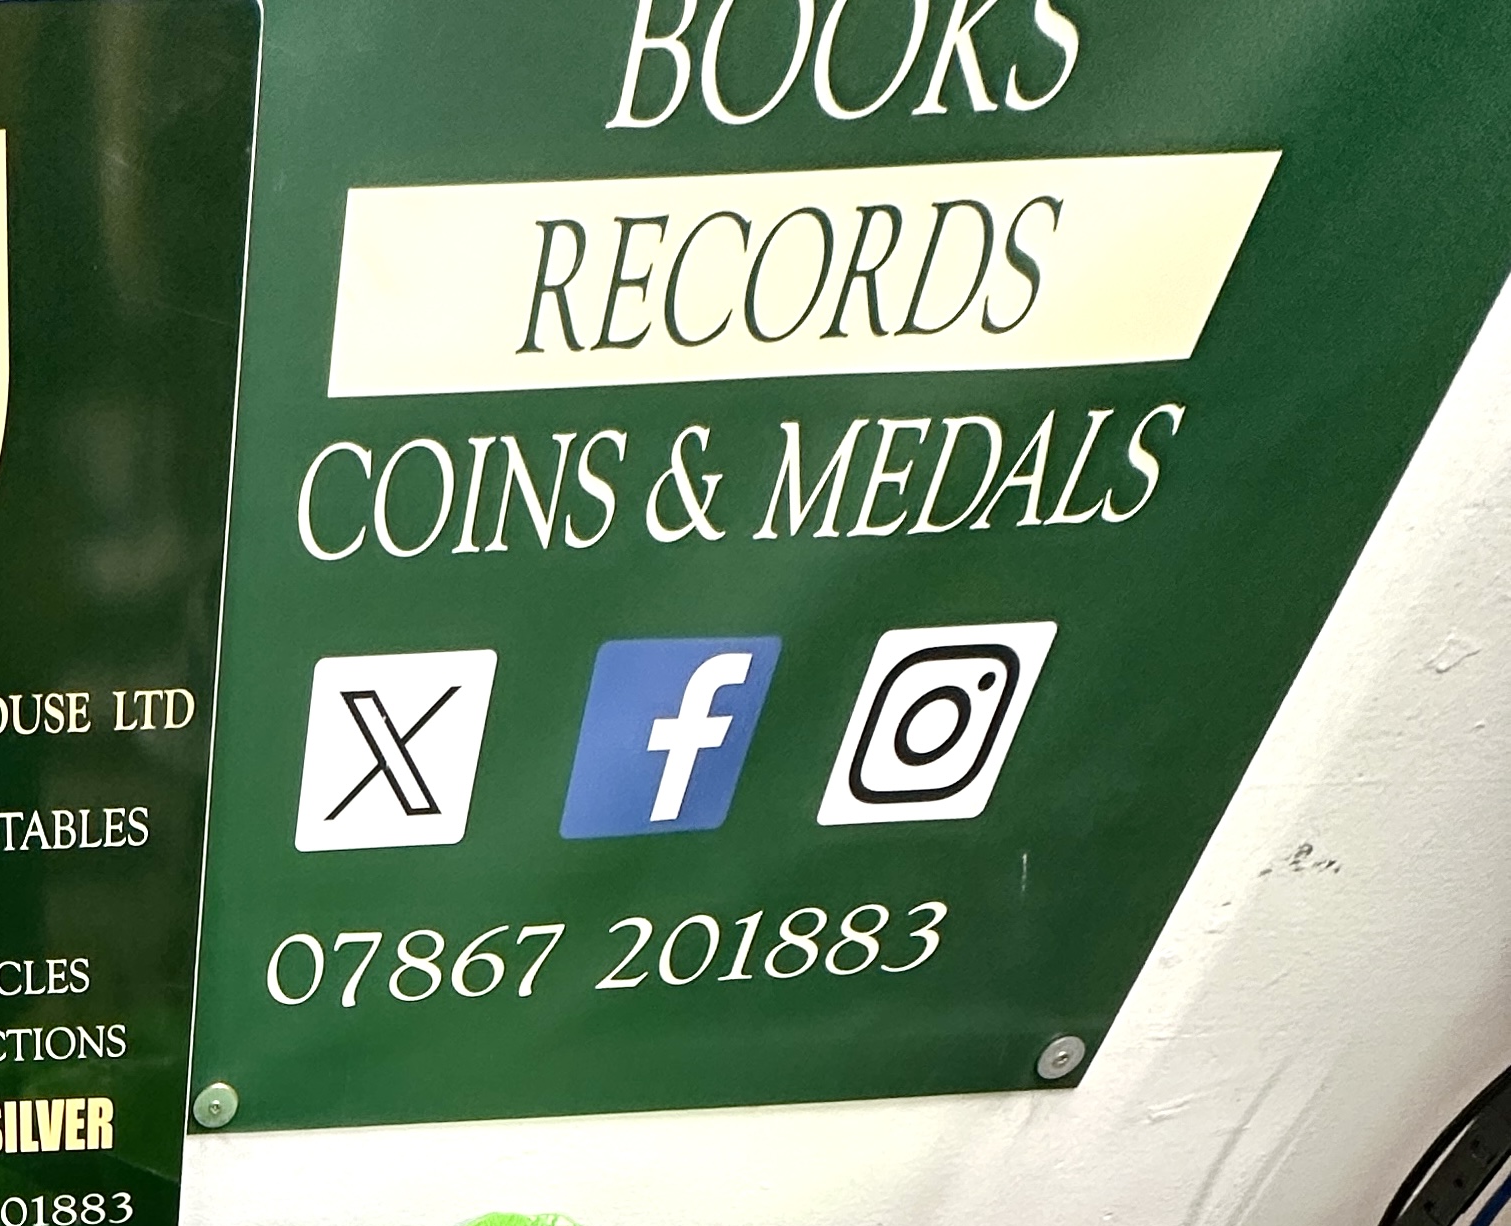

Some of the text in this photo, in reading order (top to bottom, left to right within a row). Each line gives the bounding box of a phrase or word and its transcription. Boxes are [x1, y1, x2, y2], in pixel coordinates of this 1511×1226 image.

[605, 0, 1080, 130] BOOKS
[516, 196, 1063, 354] RECORDS
[297, 404, 1186, 561] COINS & MEDALS
[112, 688, 196, 731] LTD
[266, 901, 948, 1008] 07867 201883
